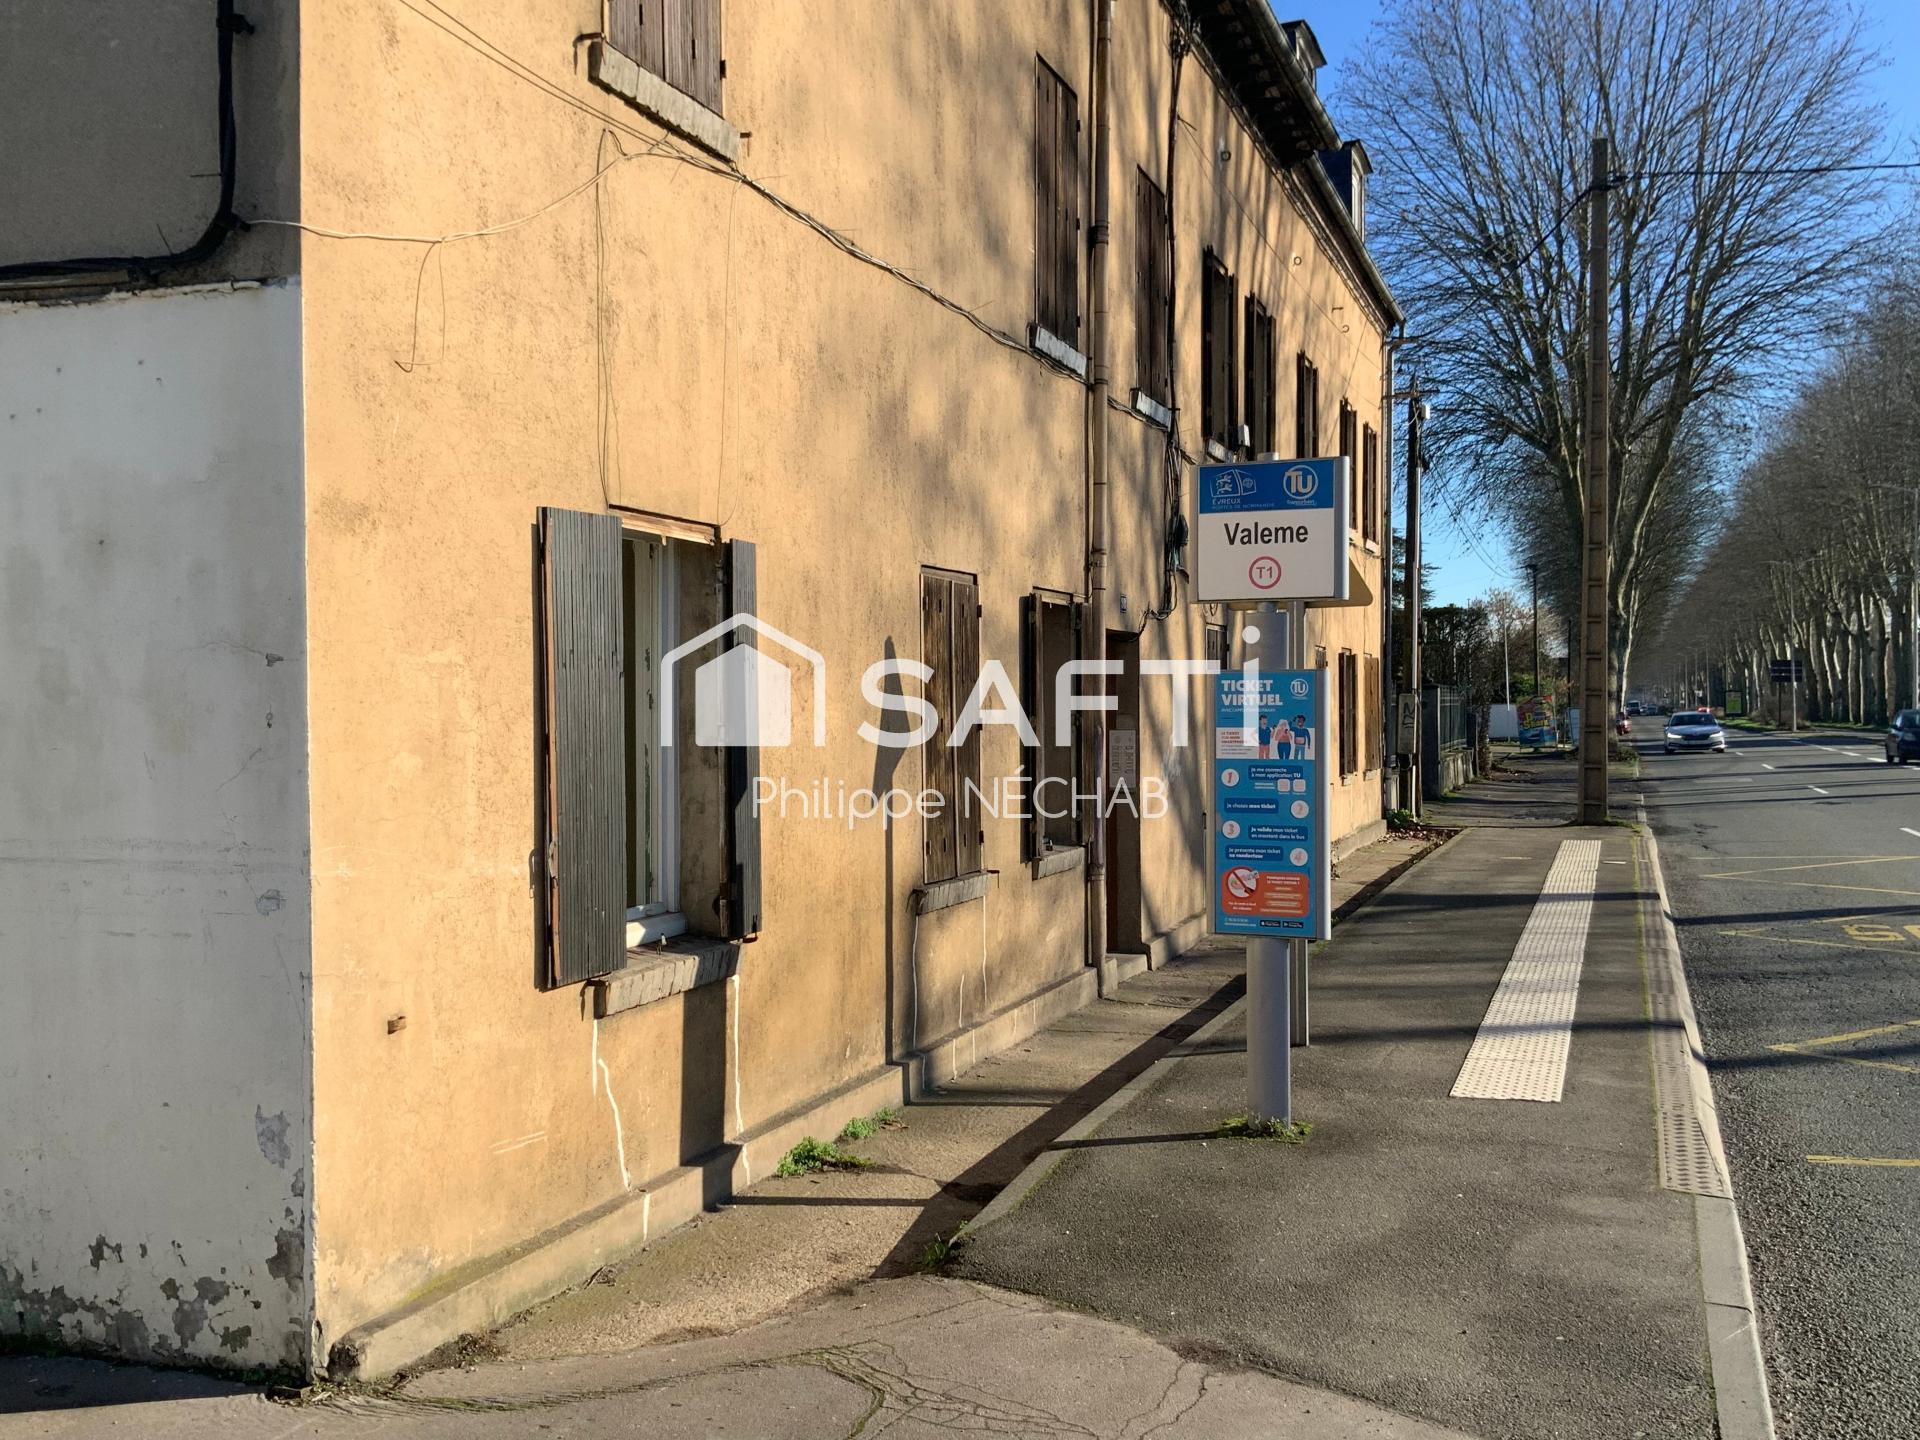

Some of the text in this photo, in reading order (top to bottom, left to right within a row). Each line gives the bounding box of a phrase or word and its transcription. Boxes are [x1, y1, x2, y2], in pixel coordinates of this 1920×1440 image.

[1284, 471, 1312, 493] TU
[1224, 522, 1308, 545] Valeme
[1255, 566, 1274, 580] T1
[1221, 679, 1274, 692] TICKET
[1221, 693, 1284, 706] VIRTUEL
